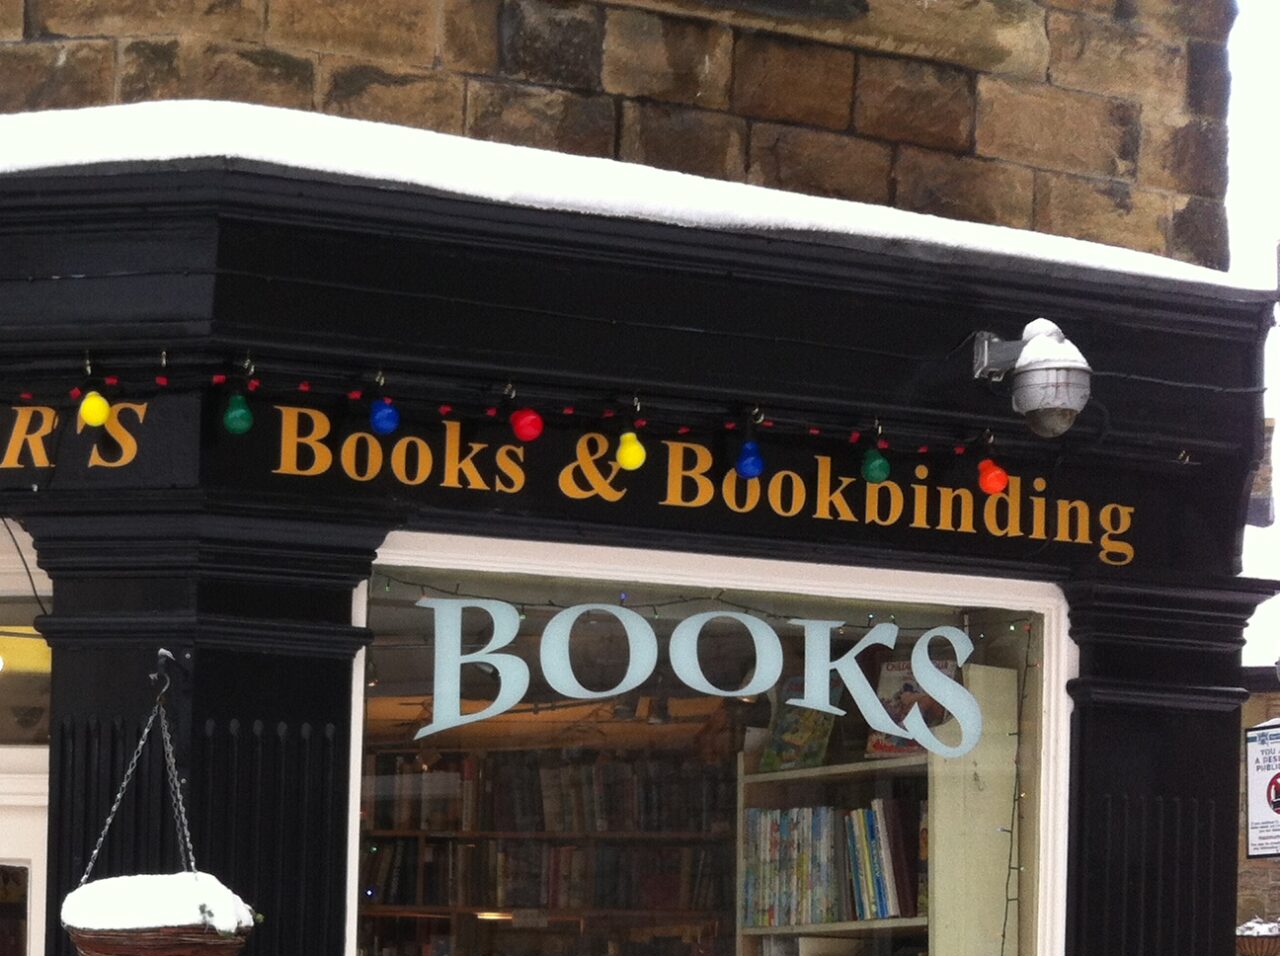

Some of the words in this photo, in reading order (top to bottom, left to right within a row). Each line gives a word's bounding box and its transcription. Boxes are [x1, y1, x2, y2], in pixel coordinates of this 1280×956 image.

[271, 405, 526, 494] Books
[558, 432, 628, 502] &
[658, 439, 1136, 567] Bookbinding
[412, 596, 983, 758] BOOKS
